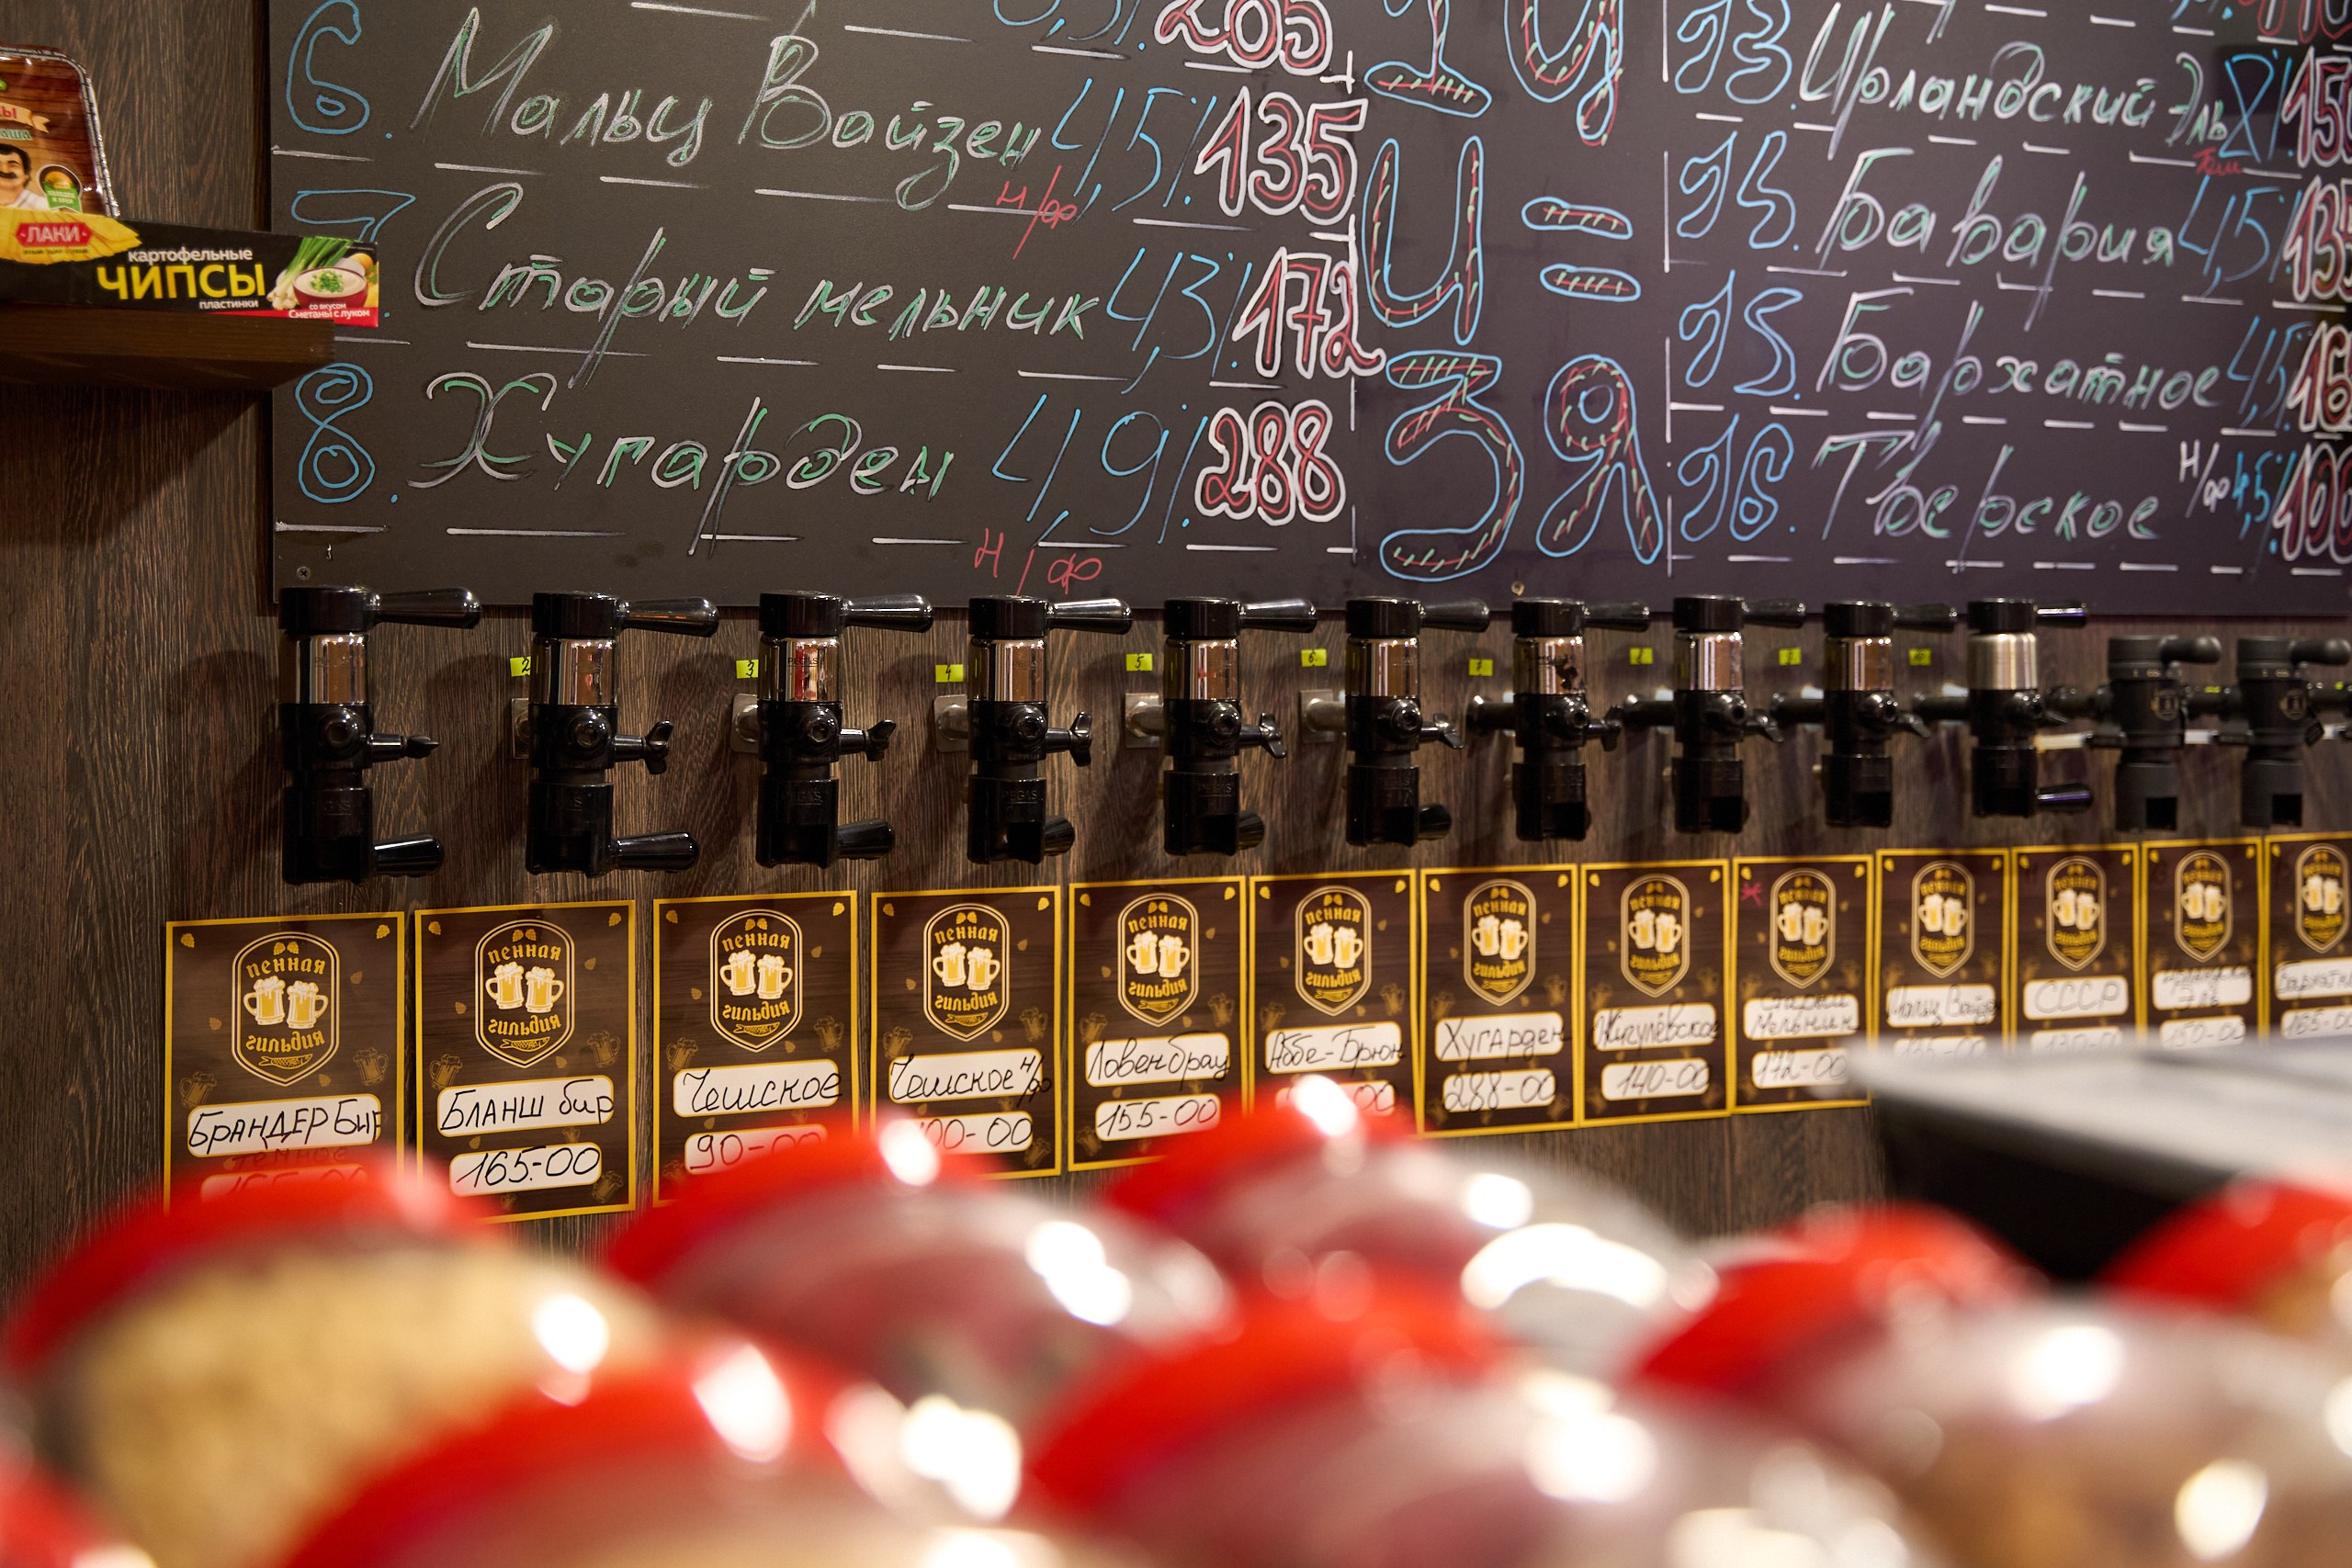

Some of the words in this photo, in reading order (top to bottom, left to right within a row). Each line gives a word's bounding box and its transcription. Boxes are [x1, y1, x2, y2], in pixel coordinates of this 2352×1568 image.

[738, 0, 1040, 212] Вайзен
[1194, 86, 1368, 224] 135
[2281, 45, 2352, 169] 15
[27, 225, 80, 243] ЛАКИ
[1815, 148, 2174, 330] Бавария
[2283, 175, 2352, 305] 13
[128, 246, 254, 266] картофельные
[96, 263, 266, 300] ЧИПСЫ
[414, 183, 776, 389] Старый
[794, 278, 1100, 341] мельник
[1232, 246, 1385, 378] 172
[198, 299, 259, 310] пластинки
[288, 309, 333, 320] Сметаны
[340, 310, 371, 320] луком
[1815, 288, 2222, 450] Бархатное
[2286, 321, 2352, 432] 16
[294, 362, 399, 504] 8.
[406, 371, 955, 557] Хугарден
[1195, 399, 1346, 525] 288
[520, 658, 531, 673] 2
[745, 660, 755, 677] 3
[944, 663, 953, 681] 4
[1134, 655, 1145, 670] 5
[1128, 913, 1188, 933] пенная
[1305, 906, 1362, 925] пенная
[721, 932, 791, 953] пенная
[933, 926, 999, 945] пенная
[487, 944, 561, 965] пенная
[246, 956, 325, 979] пенная
[1305, 967, 1362, 987] гильдия
[1128, 977, 1188, 998] гильдия
[2033, 979, 2121, 1013] СССР
[721, 998, 791, 1021] гильдия
[933, 990, 1000, 1011] гильдия
[488, 1013, 562, 1037] гильдия
[245, 1030, 325, 1054] гильдия
[1086, 1030, 1231, 1093] Ловенбрау
[890, 1053, 1014, 1100] Чешское
[1616, 1062, 1711, 1098] 140-00
[559, 1078, 615, 1124] бир
[683, 1068, 843, 1113] Чешское
[1443, 1071, 1558, 1111] 288-00
[1097, 1099, 1218, 1137] 155-00
[919, 1116, 1035, 1151] 00-00
